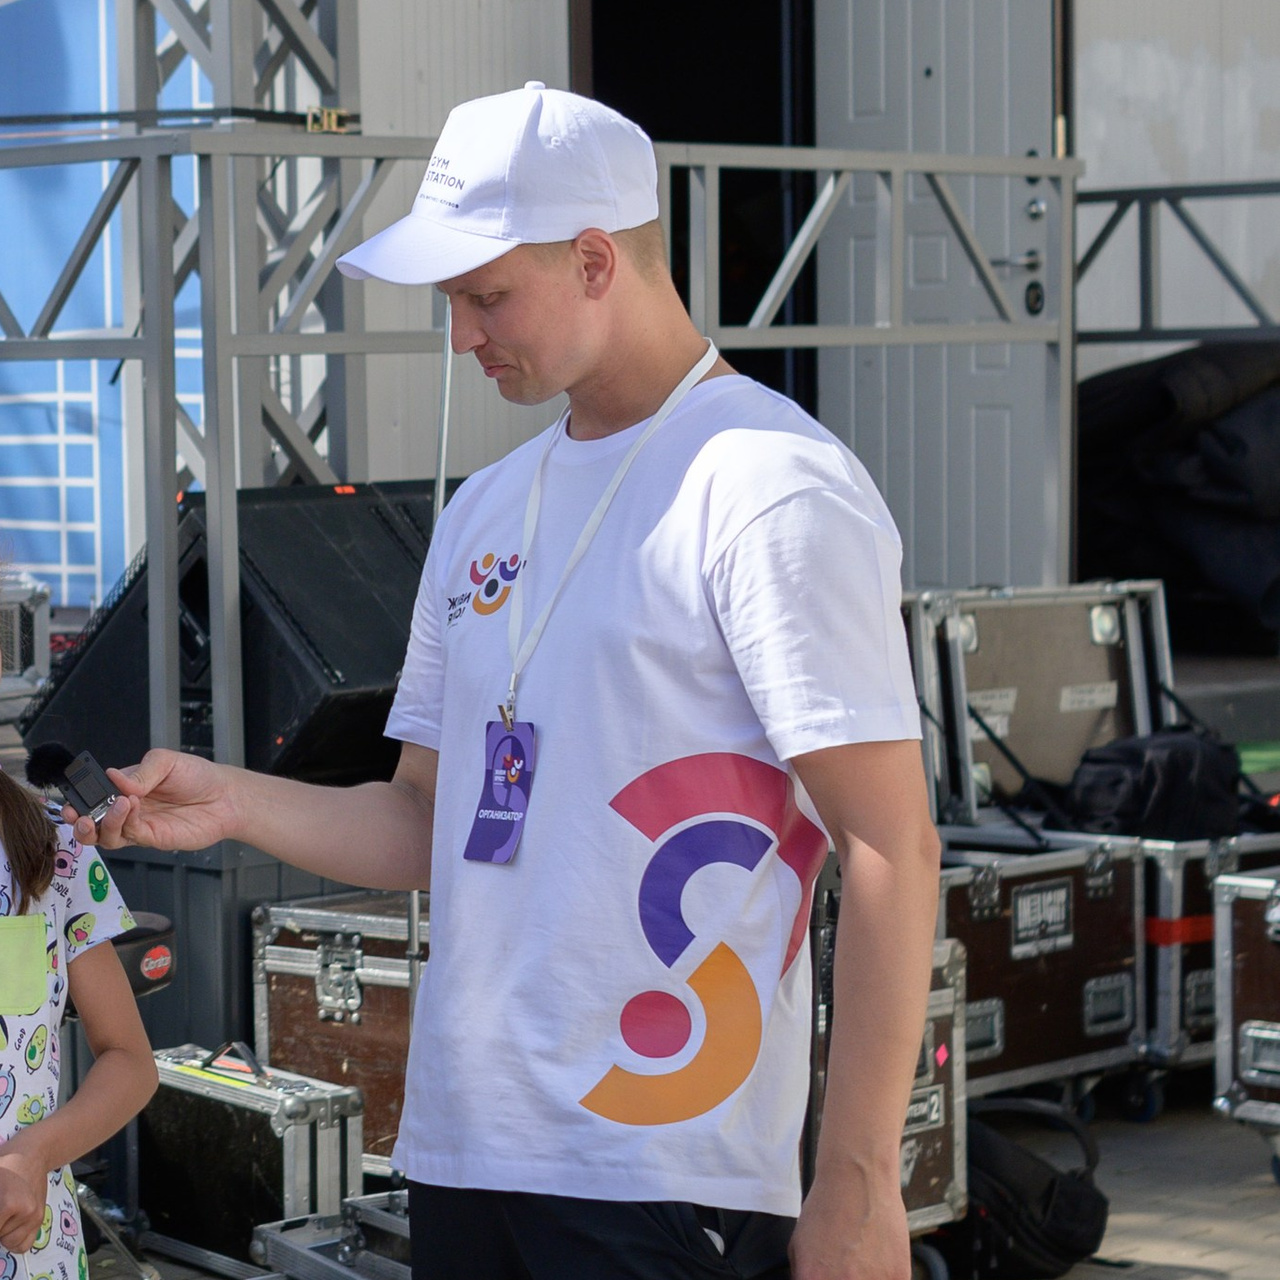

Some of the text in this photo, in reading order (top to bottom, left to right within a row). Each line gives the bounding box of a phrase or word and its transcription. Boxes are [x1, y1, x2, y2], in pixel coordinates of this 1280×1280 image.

[426, 170, 466, 190] STATION
[478, 809, 524, 821] ОРГАНИЗАТОР
[14, 1027, 26, 1051] GOOD
[929, 1093, 939, 1121] 2
